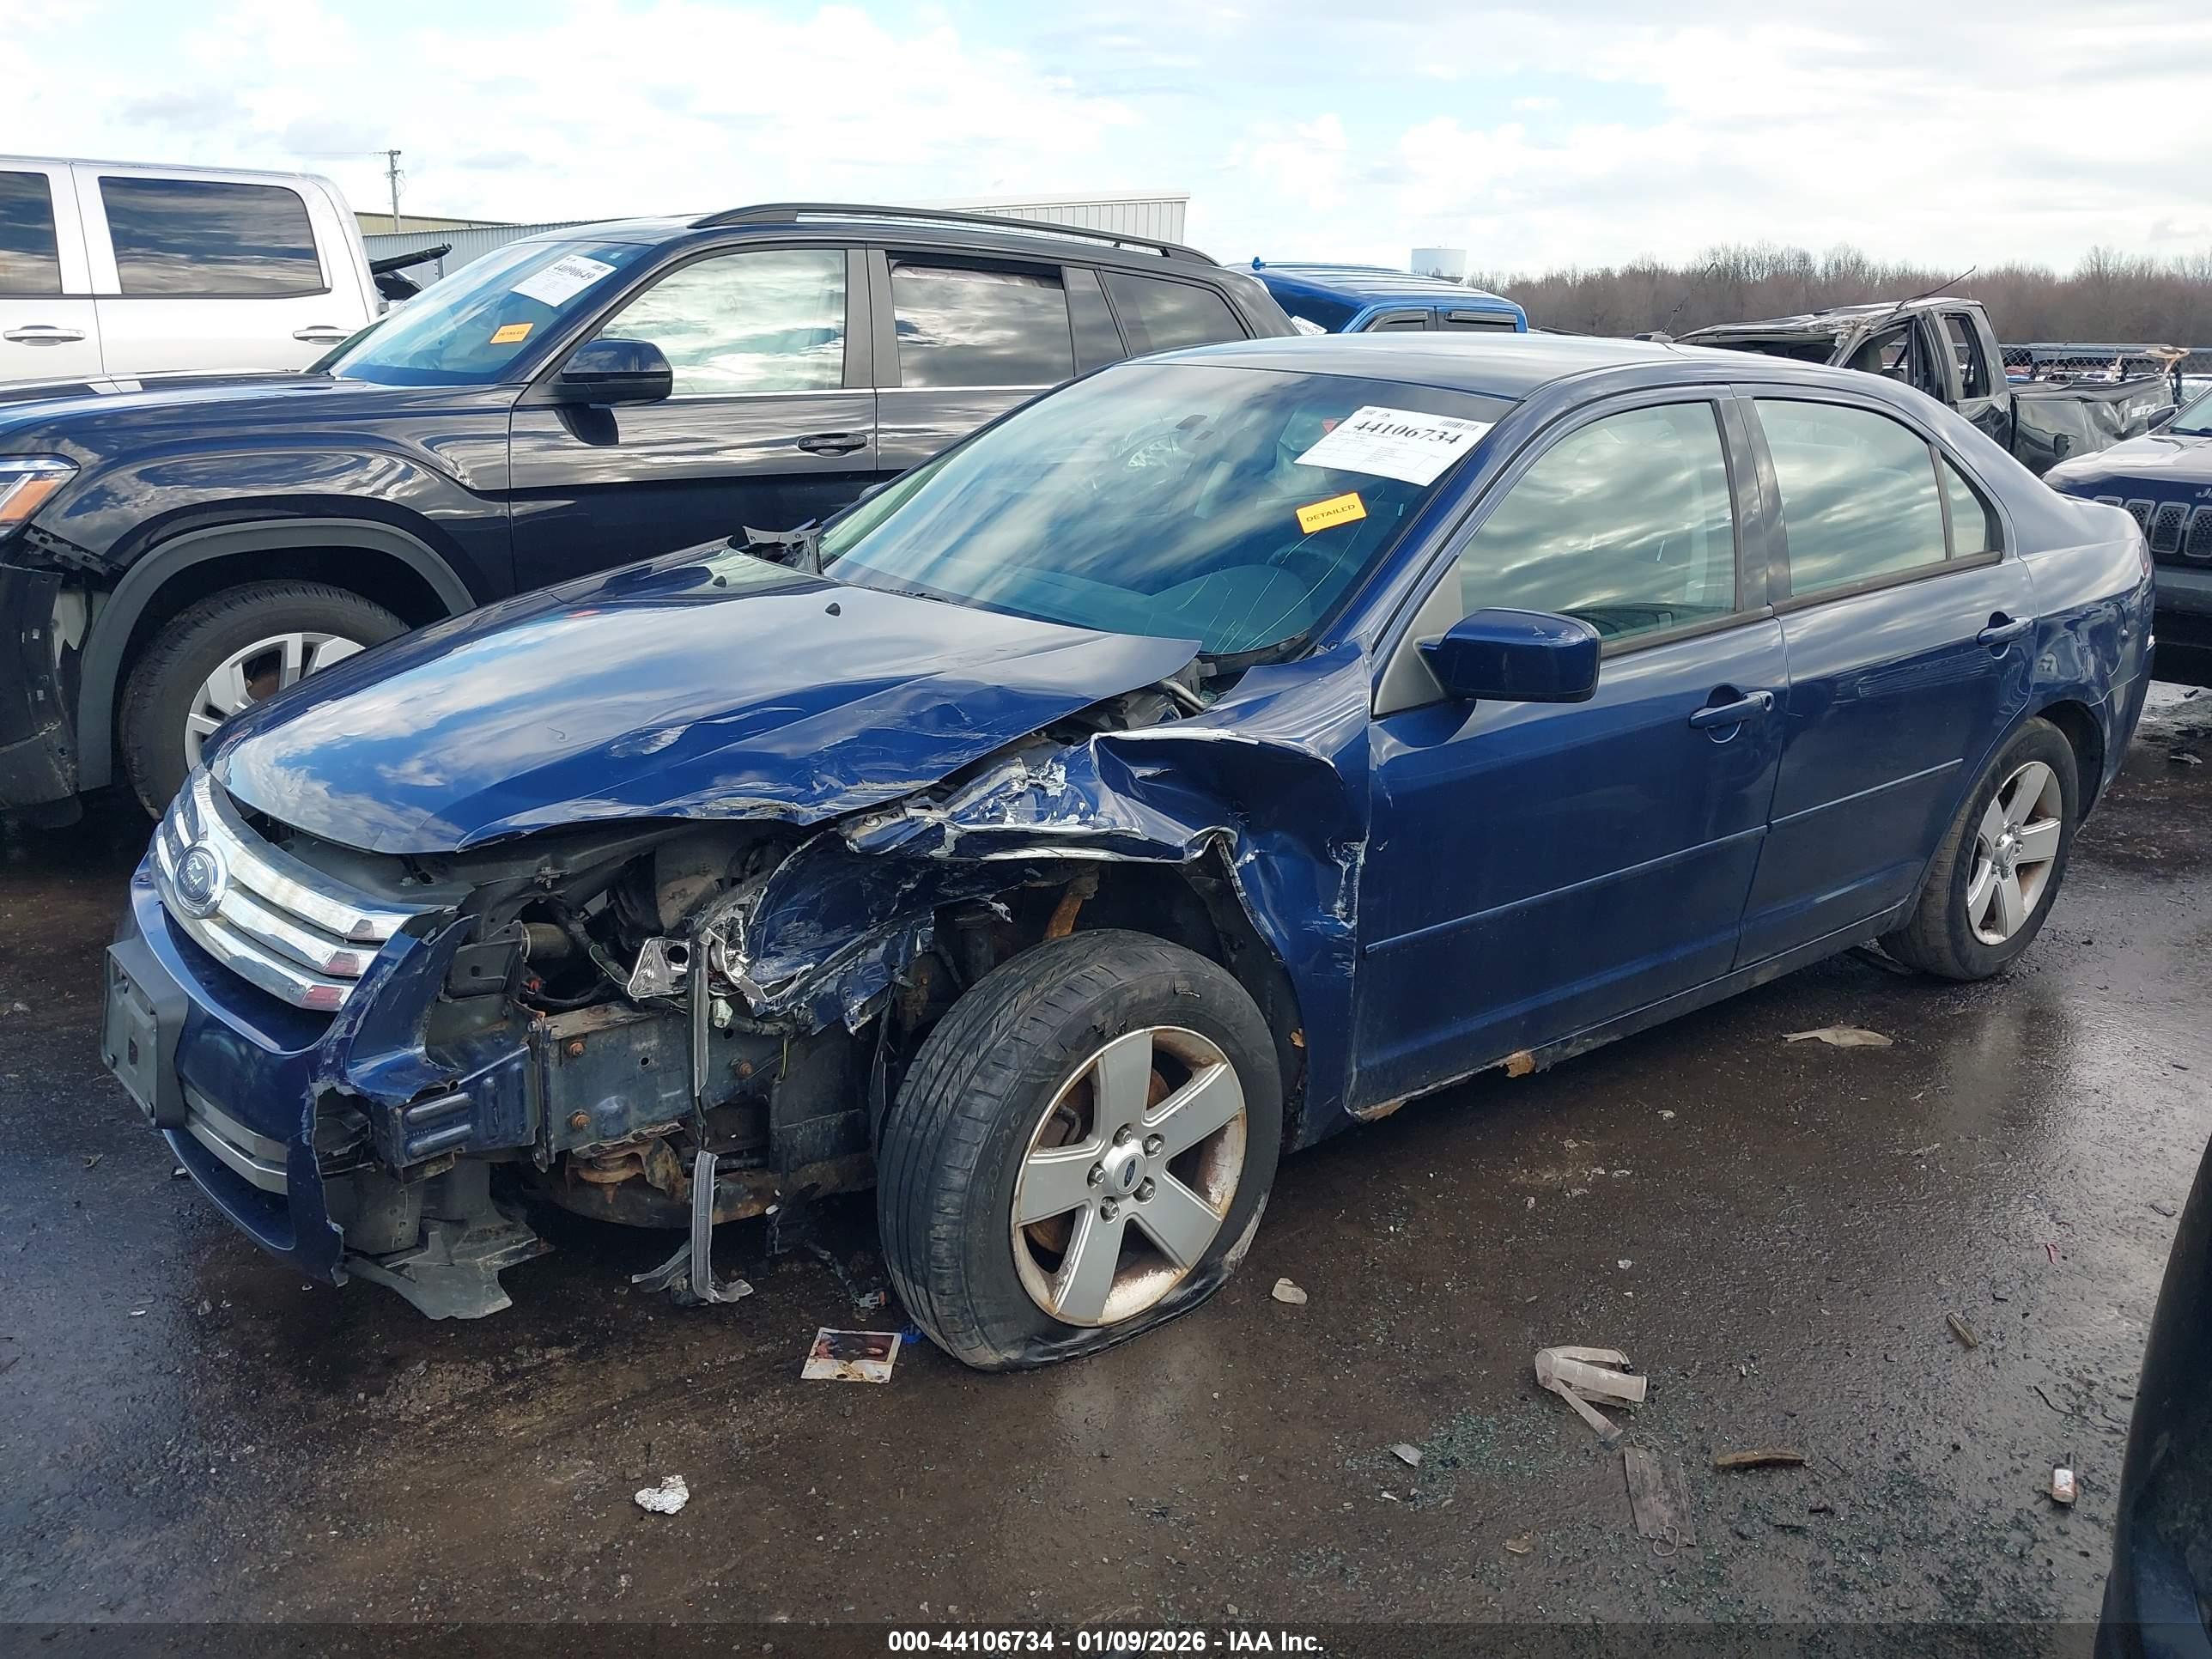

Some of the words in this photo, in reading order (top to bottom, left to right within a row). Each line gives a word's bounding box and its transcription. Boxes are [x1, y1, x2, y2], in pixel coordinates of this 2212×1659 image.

[2130, 403, 2157, 417] STX
[1352, 420, 1463, 445] 44106734
[1305, 504, 1356, 522] DETAILED
